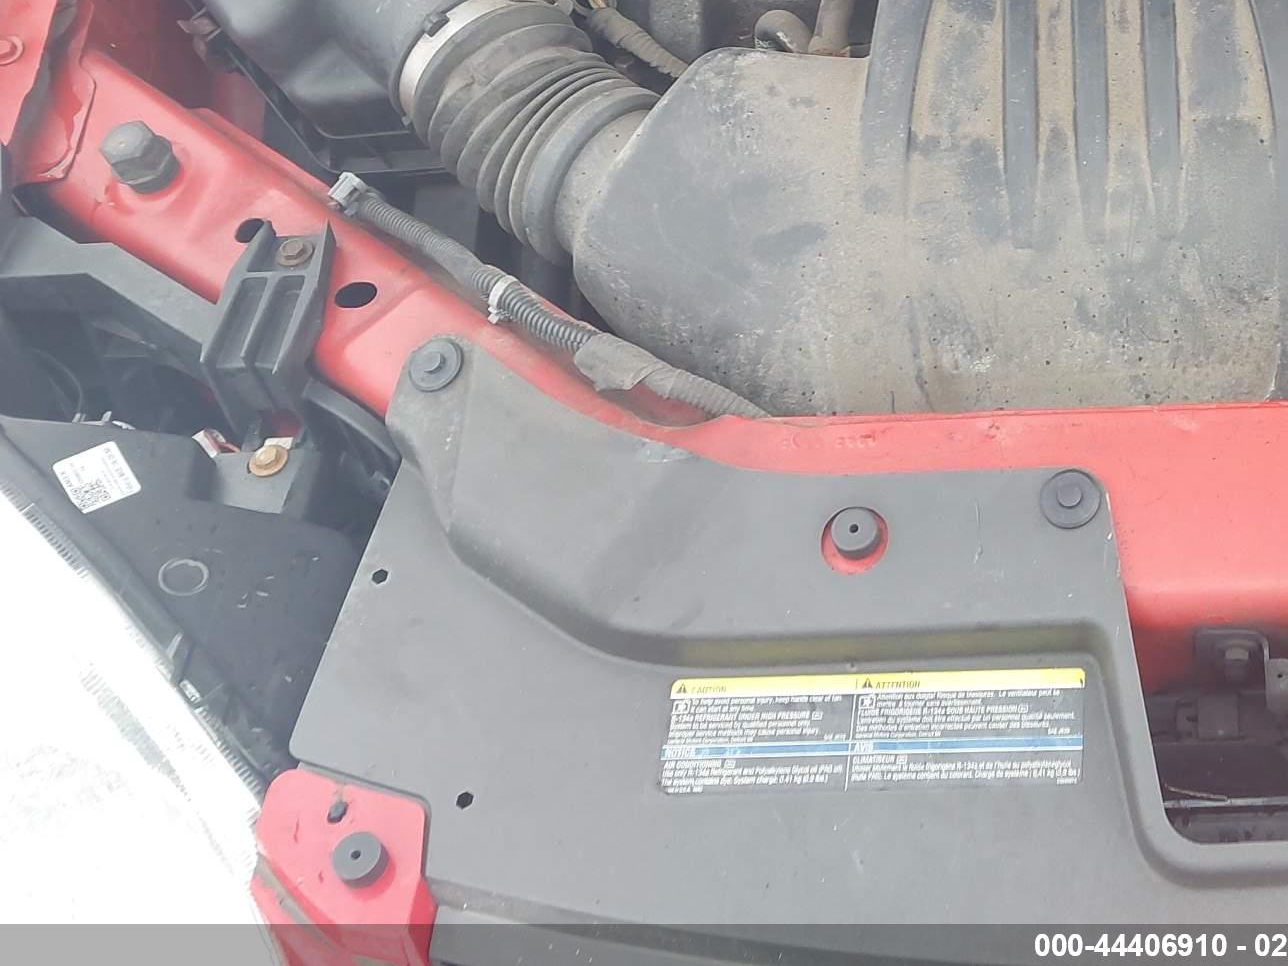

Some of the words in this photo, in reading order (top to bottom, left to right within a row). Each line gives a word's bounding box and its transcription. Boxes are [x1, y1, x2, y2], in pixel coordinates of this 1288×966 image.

[875, 681, 921, 689] ATTENTION
[691, 687, 727, 695] CAUTION
[777, 711, 809, 720] PRESSURE
